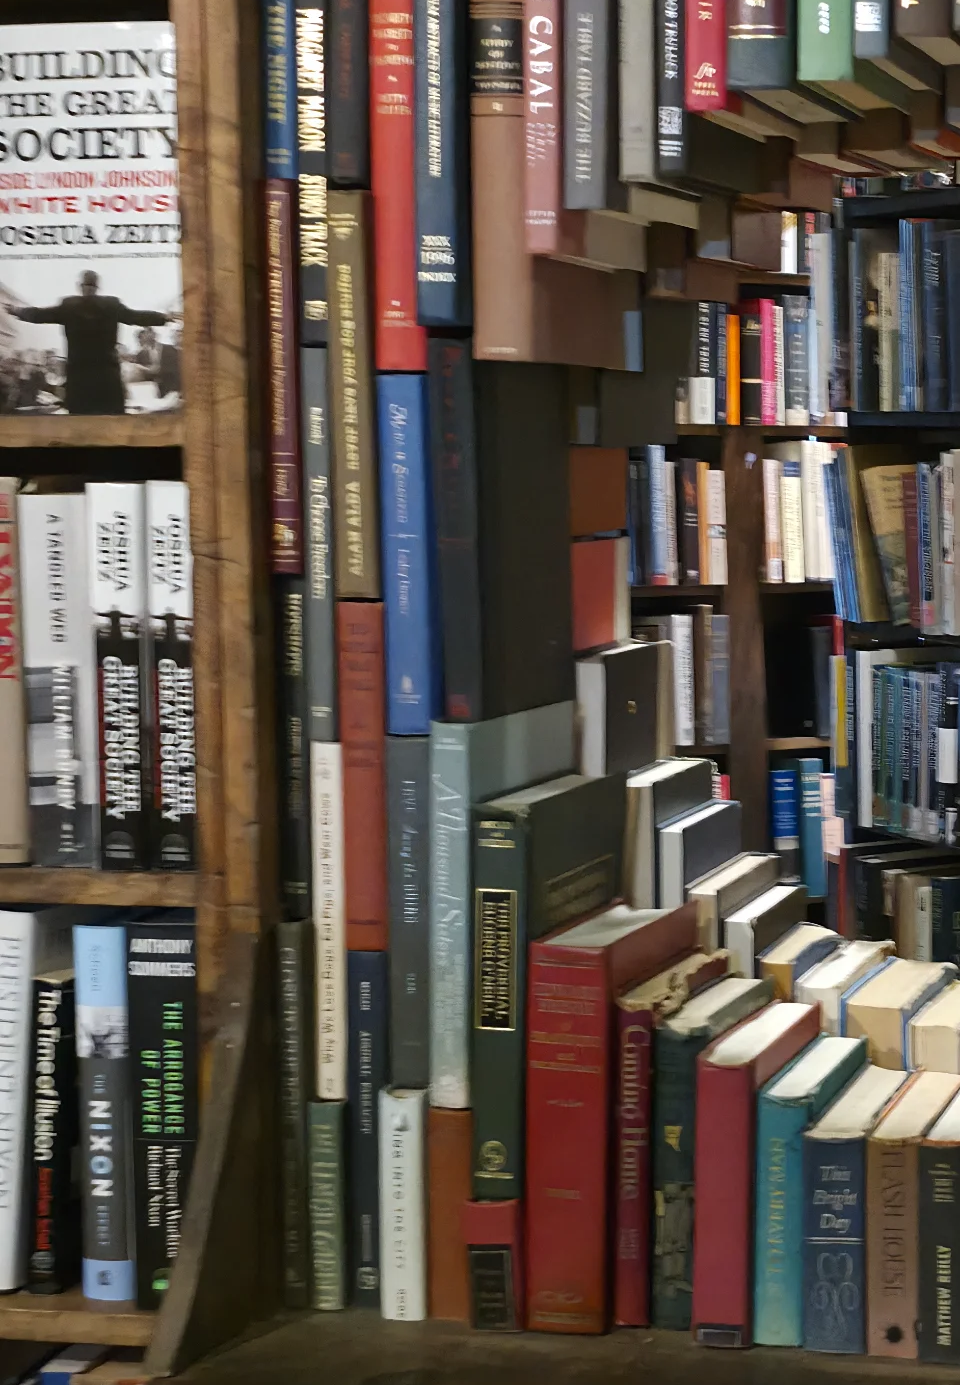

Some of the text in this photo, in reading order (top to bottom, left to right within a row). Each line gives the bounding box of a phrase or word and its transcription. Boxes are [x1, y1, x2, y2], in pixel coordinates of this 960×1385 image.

[530, 15, 554, 115] CABAL
[37, 990, 61, 1023] The
[36, 1028, 61, 1071] Time
[34, 1101, 60, 1161] Illusion
[89, 1100, 113, 1197] NIXON
[937, 1245, 952, 1346] MATTHEW REILLY
